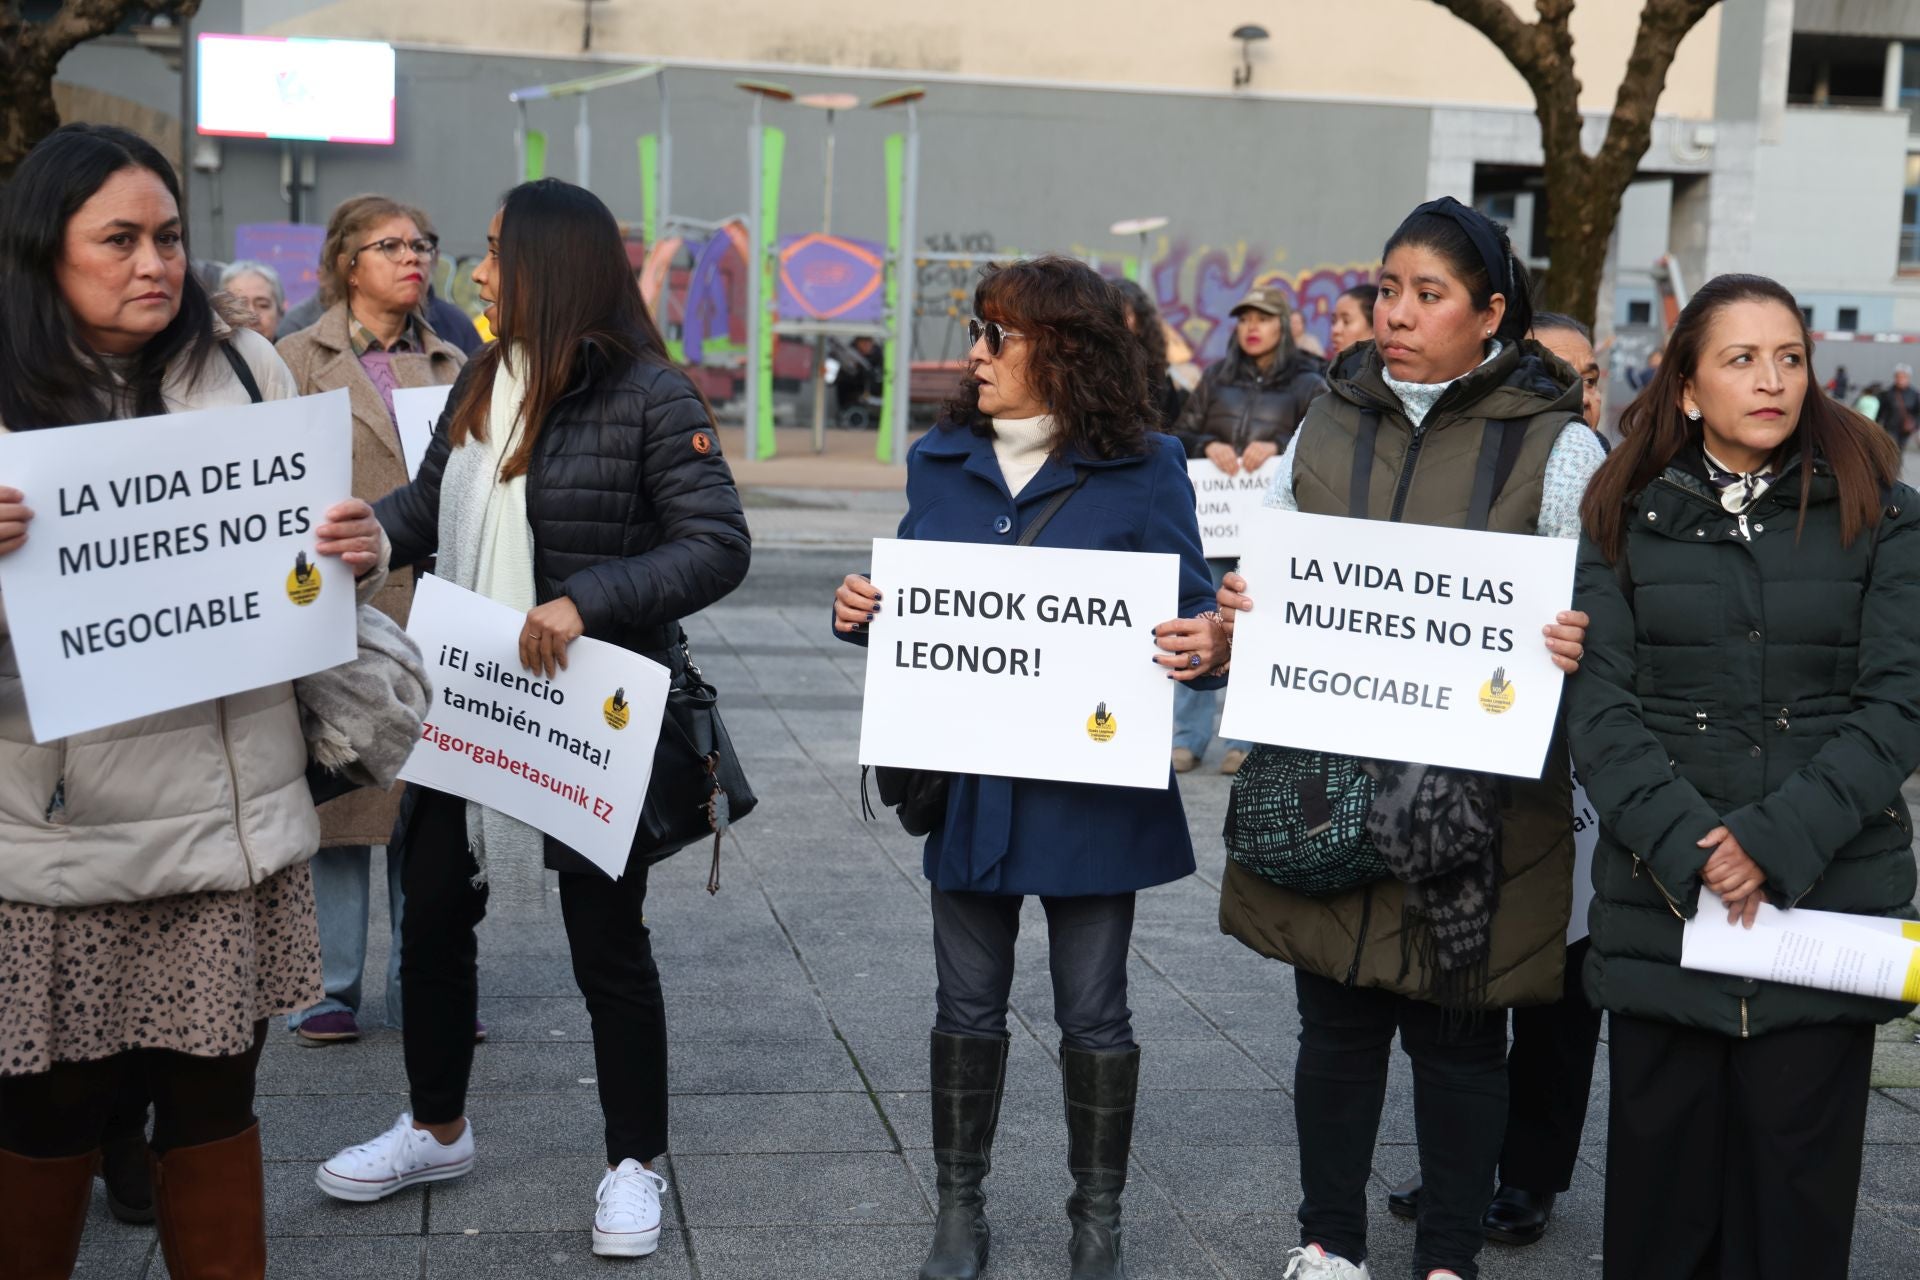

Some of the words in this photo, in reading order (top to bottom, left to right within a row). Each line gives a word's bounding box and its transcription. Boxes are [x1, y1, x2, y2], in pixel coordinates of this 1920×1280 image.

[58, 483, 100, 517] LA
[108, 470, 192, 509] VIDA
[201, 461, 242, 494] DE
[252, 451, 307, 487] LAS
[1198, 502, 1230, 515] UNA
[1202, 478, 1234, 492] UNA
[58, 522, 209, 577] MUJERES
[219, 513, 267, 549] NO
[278, 505, 311, 538] ES
[1202, 525, 1239, 538] NOS!
[1290, 557, 1324, 583] LA
[1332, 561, 1404, 592] VIDA
[1414, 571, 1452, 598] DE
[1462, 576, 1514, 606] LAS
[60, 591, 261, 659] NEGOCIABLE
[896, 586, 1026, 621] ¡DENOK
[1036, 594, 1132, 628] GARA
[1285, 601, 1416, 641] MUJERES
[1426, 619, 1471, 647] NO
[1481, 626, 1514, 653] ES
[439, 644, 469, 673] ¡El
[473, 660, 565, 706] silencio
[895, 640, 1041, 678] LEONOR!
[1270, 663, 1452, 710] NEGOCIABLE
[443, 686, 541, 738] también
[547, 727, 611, 771] mata!
[421, 722, 589, 810] Zigorgabetasunik
[593, 797, 614, 824] EZ
